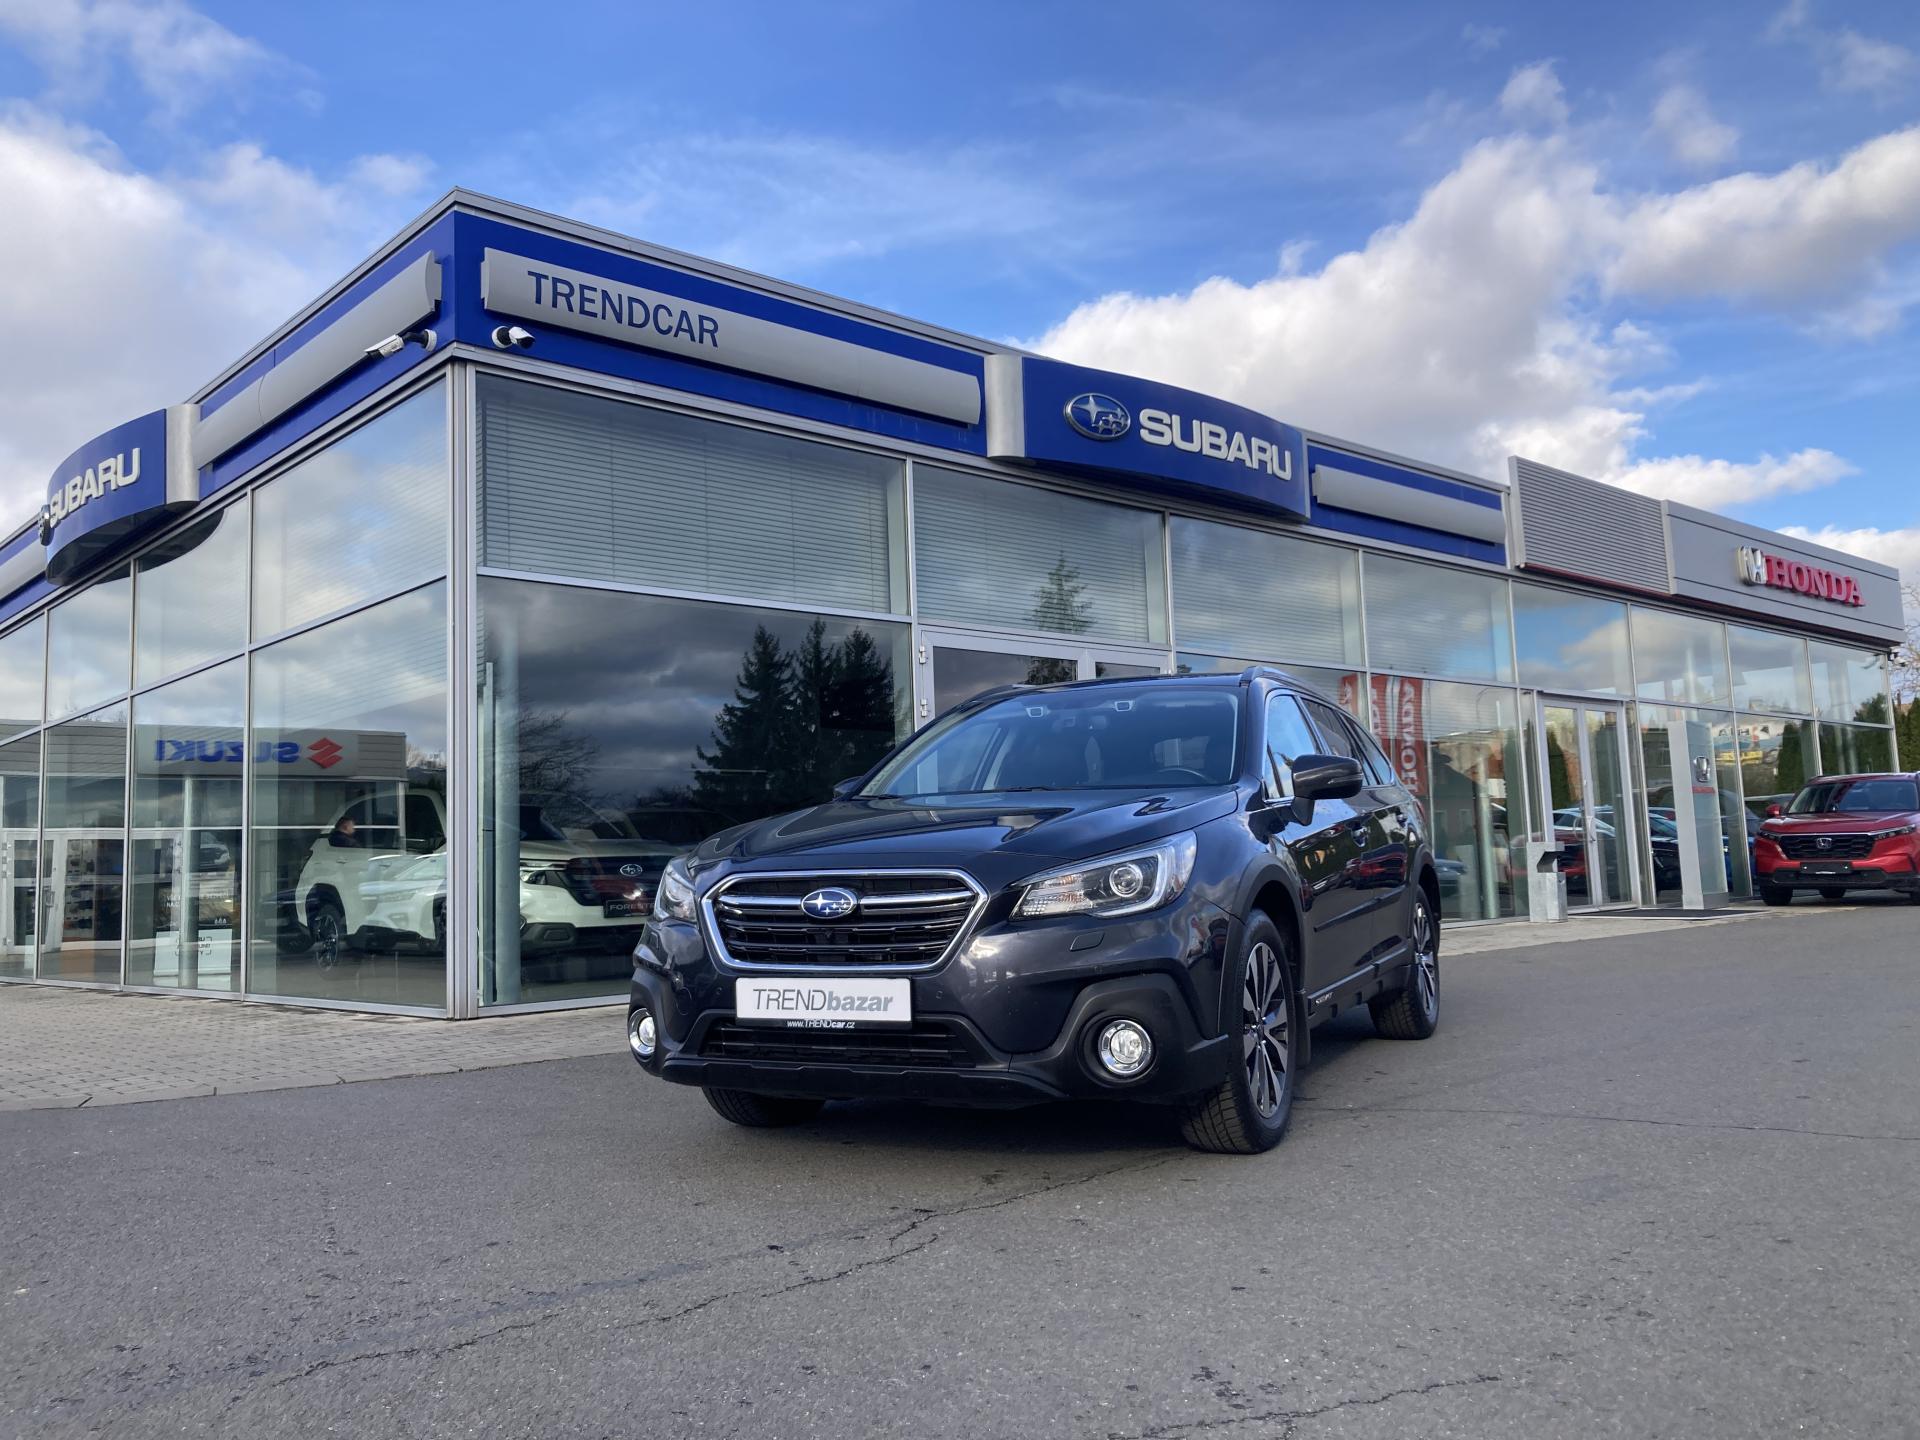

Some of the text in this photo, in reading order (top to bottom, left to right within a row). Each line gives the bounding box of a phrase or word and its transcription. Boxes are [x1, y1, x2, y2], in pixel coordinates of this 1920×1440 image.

[527, 270, 719, 348] TRENDCAR
[1139, 408, 1292, 481] SUBARU
[50, 447, 140, 528] SUBARU
[1764, 555, 1866, 606] HONDA
[753, 988, 893, 1012] TRENDbazar
[786, 1019, 856, 1029] www.TRENDcar.cz
